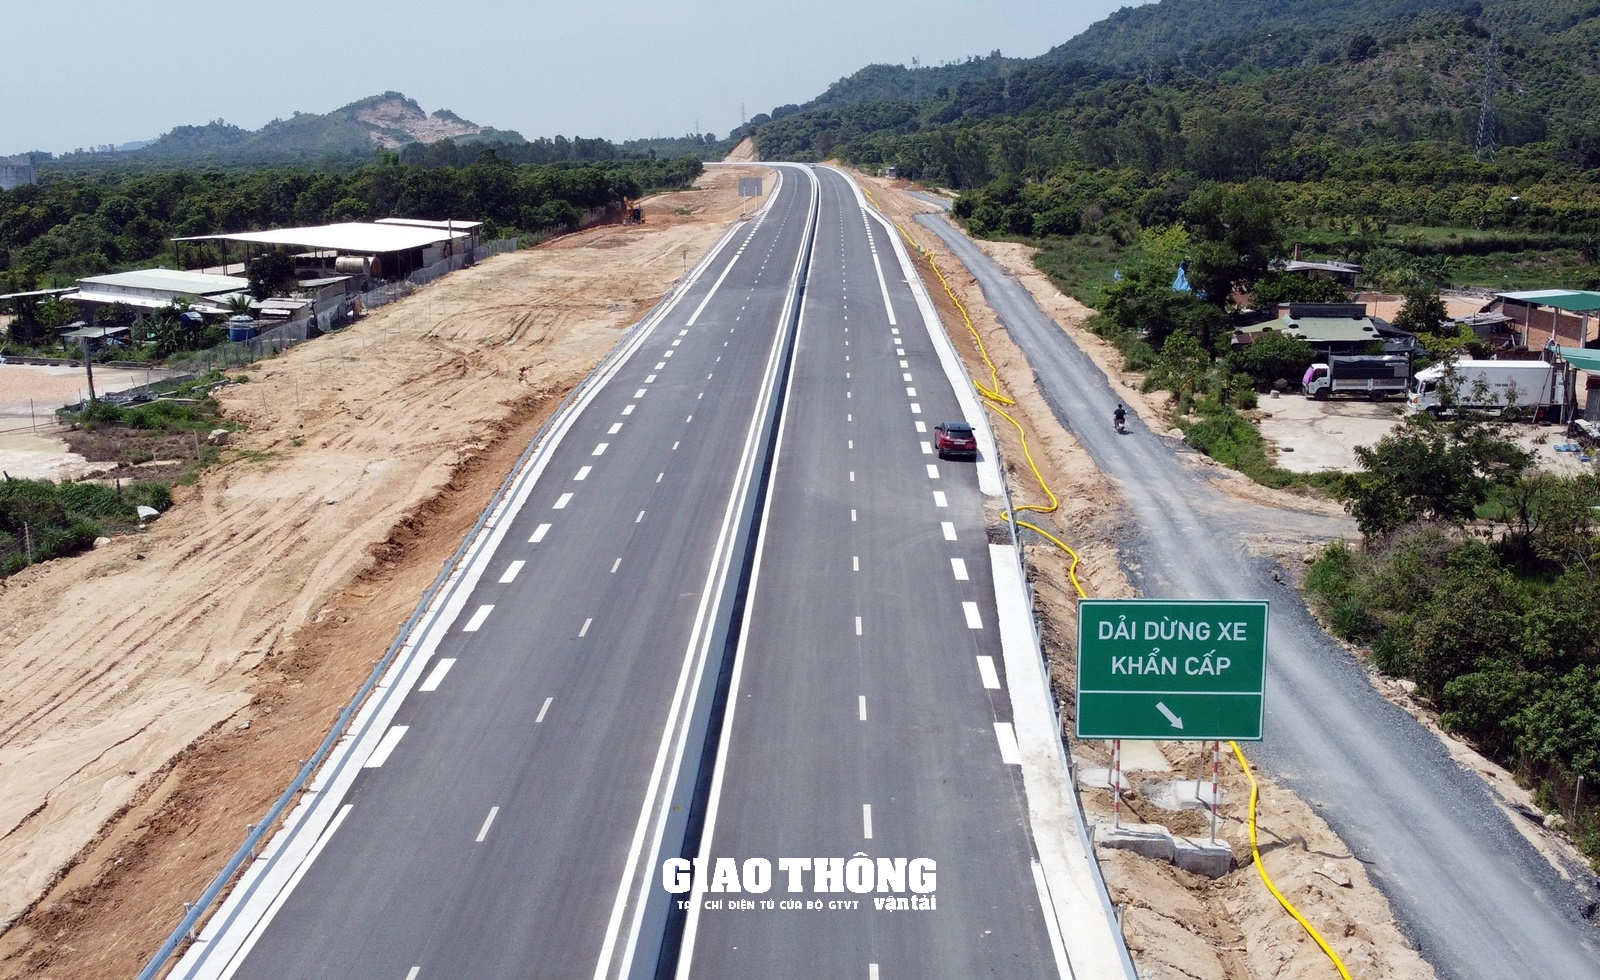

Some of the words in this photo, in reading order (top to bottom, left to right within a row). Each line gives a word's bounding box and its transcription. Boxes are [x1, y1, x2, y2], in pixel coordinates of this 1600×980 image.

[1098, 614, 1136, 641] DẢI
[1144, 615, 1211, 641] DỪNG
[1217, 622, 1248, 641] XE
[1111, 647, 1177, 675] KHẨN
[1184, 649, 1231, 676] CẤP
